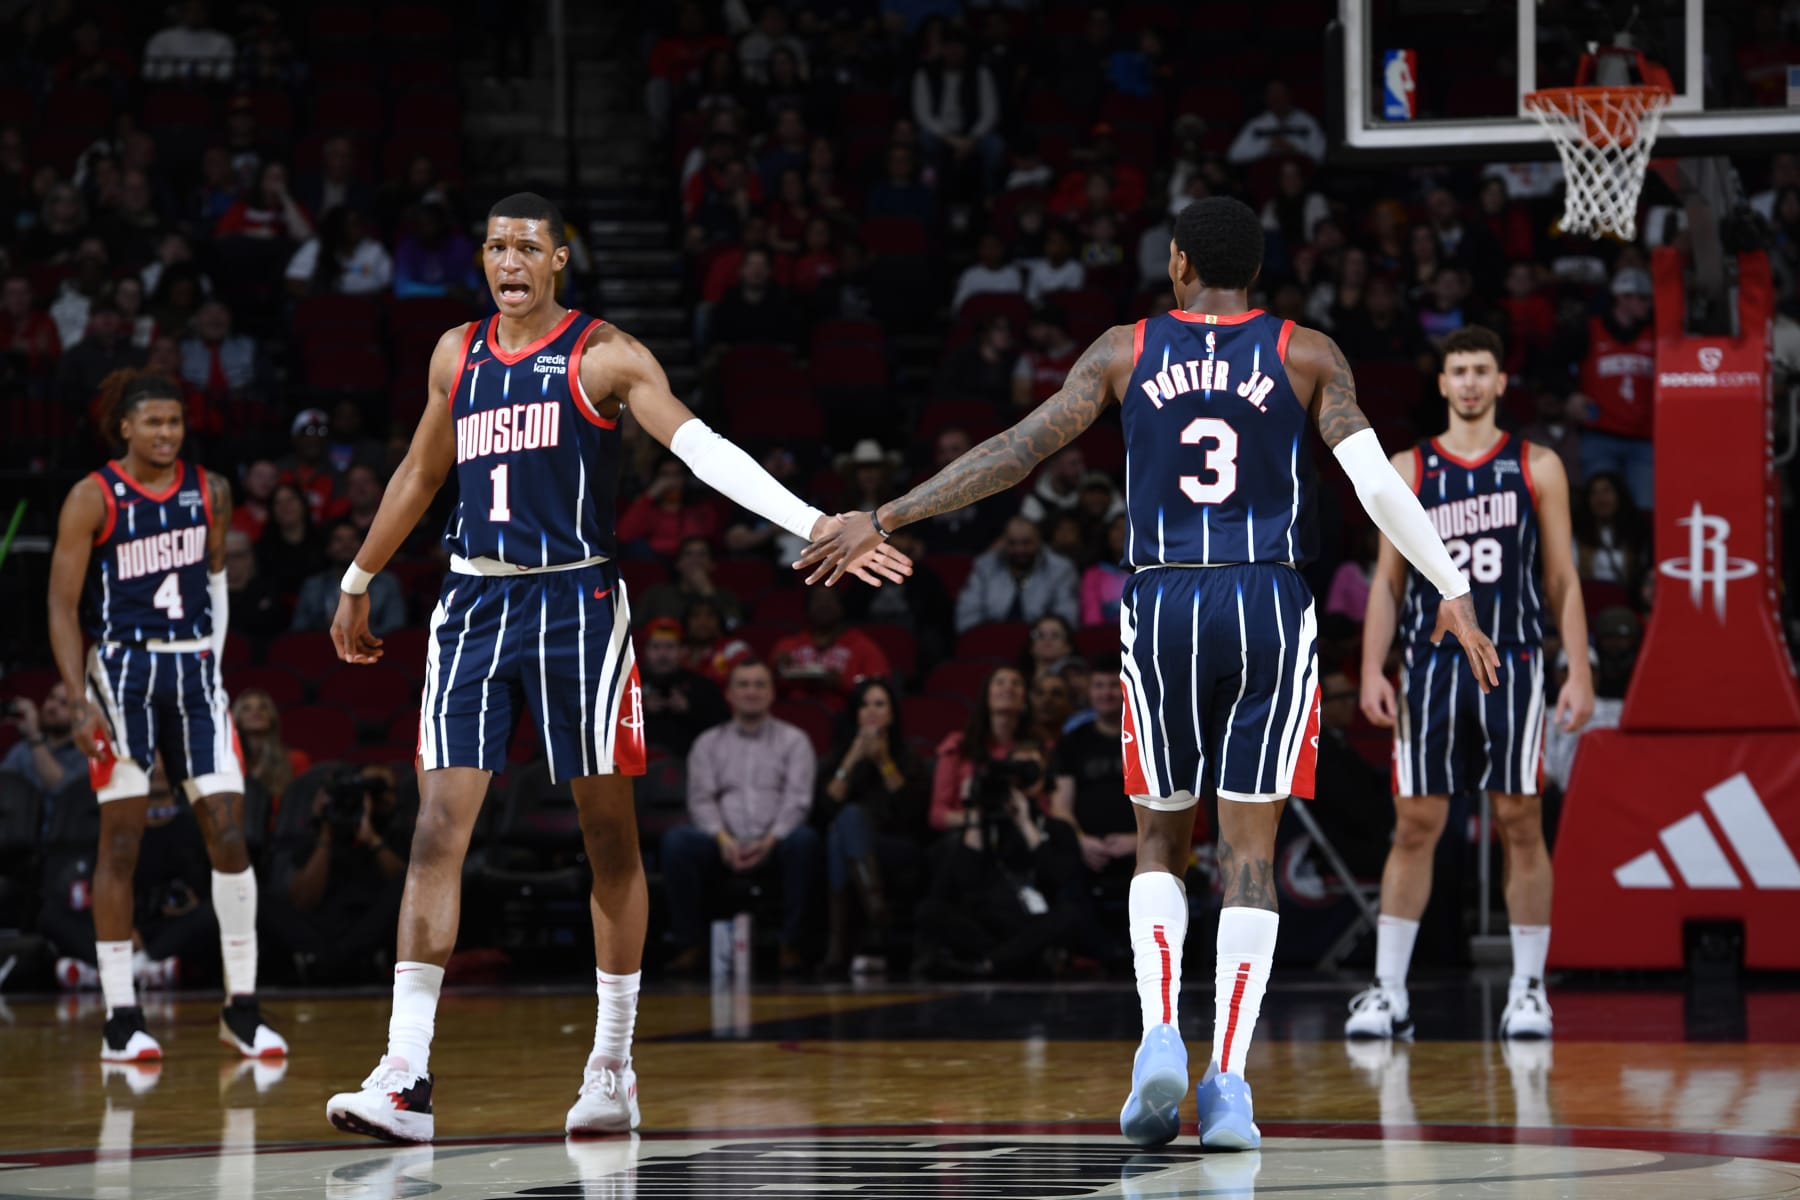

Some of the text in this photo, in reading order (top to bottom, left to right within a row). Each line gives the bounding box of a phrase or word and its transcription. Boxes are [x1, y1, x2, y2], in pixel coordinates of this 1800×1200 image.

[471, 339, 484, 354] 6
[533, 362, 567, 375] karma
[536, 354, 566, 365] credit
[1141, 359, 1275, 413] PORTER JR.
[456, 401, 561, 465] HOUSTON
[1178, 417, 1239, 505] 3
[488, 462, 512, 523] 1
[116, 524, 208, 582] HOUSTON
[1444, 537, 1503, 584] 28
[152, 572, 185, 620] 4
